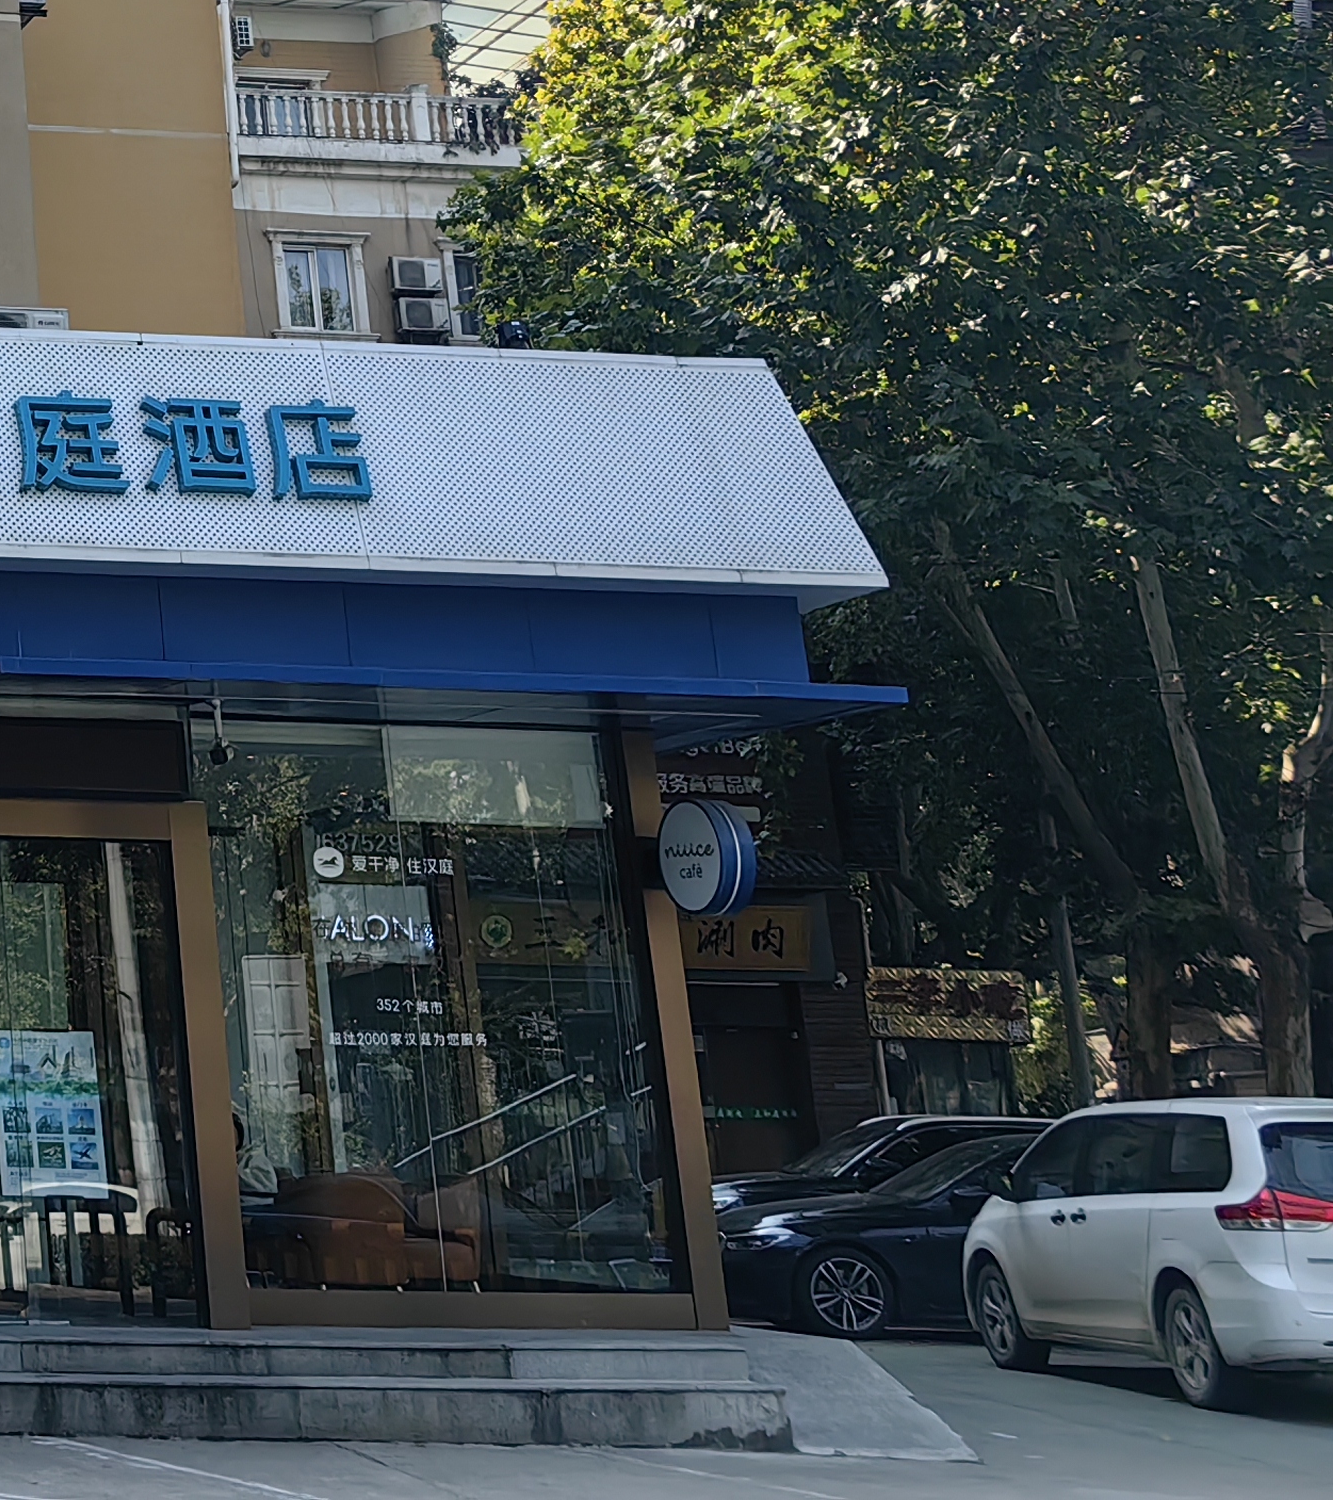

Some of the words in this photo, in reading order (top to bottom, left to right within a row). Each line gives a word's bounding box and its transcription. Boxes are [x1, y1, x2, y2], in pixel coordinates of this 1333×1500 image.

[351, 855, 400, 873] 爱干净
[407, 857, 455, 876] 住汉庭
[376, 998, 443, 1015] 352个城市
